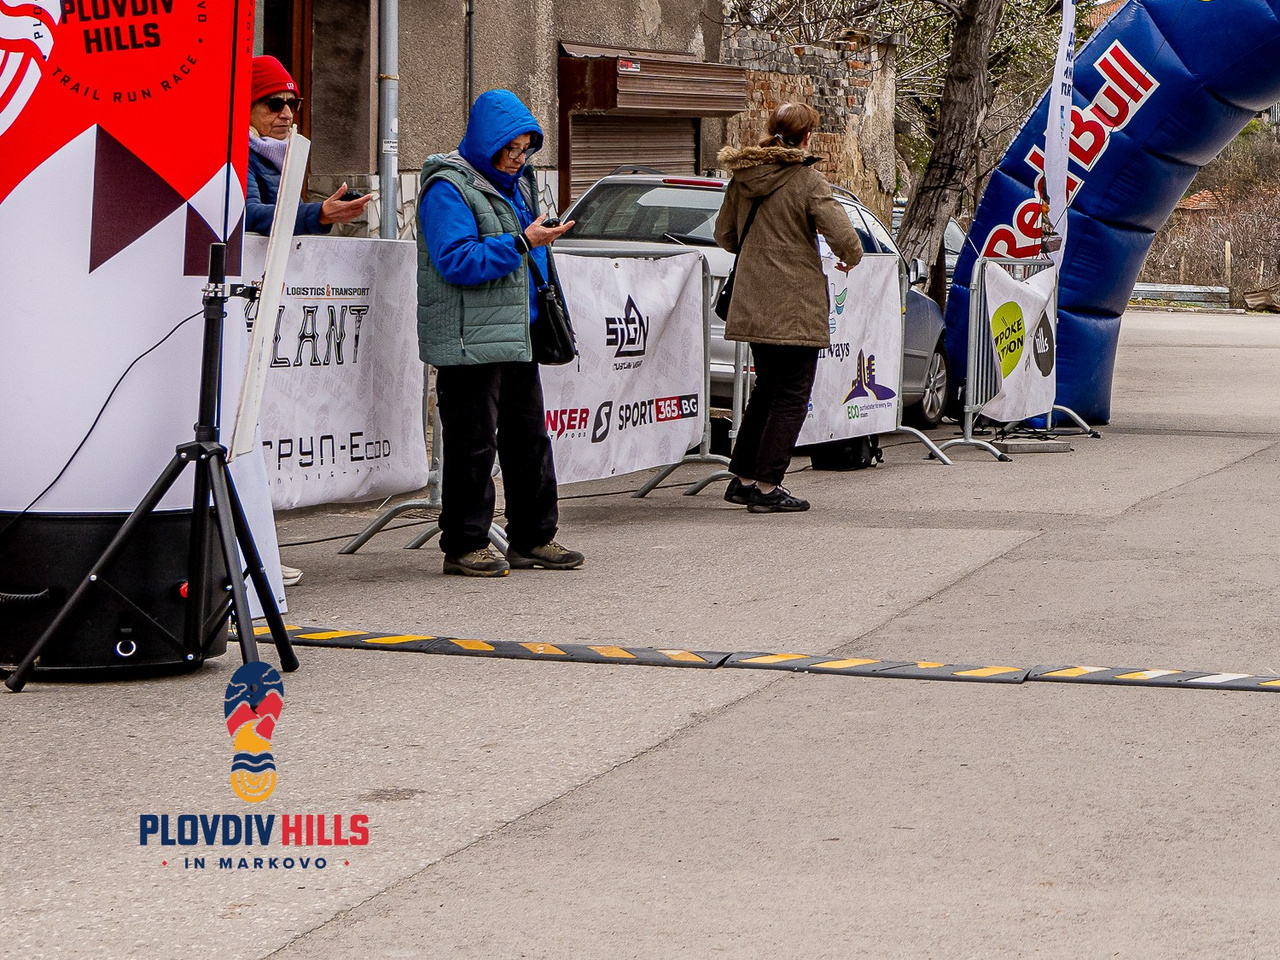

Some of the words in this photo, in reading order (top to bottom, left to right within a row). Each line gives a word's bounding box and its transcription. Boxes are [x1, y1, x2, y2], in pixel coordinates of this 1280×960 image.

[83, 22, 161, 55] HILLS
[52, 66, 101, 101] TRAIL
[113, 87, 153, 104] RUN
[160, 54, 198, 91] RACE
[1066, 38, 1161, 172] Bull
[847, 404, 860, 420] ECO
